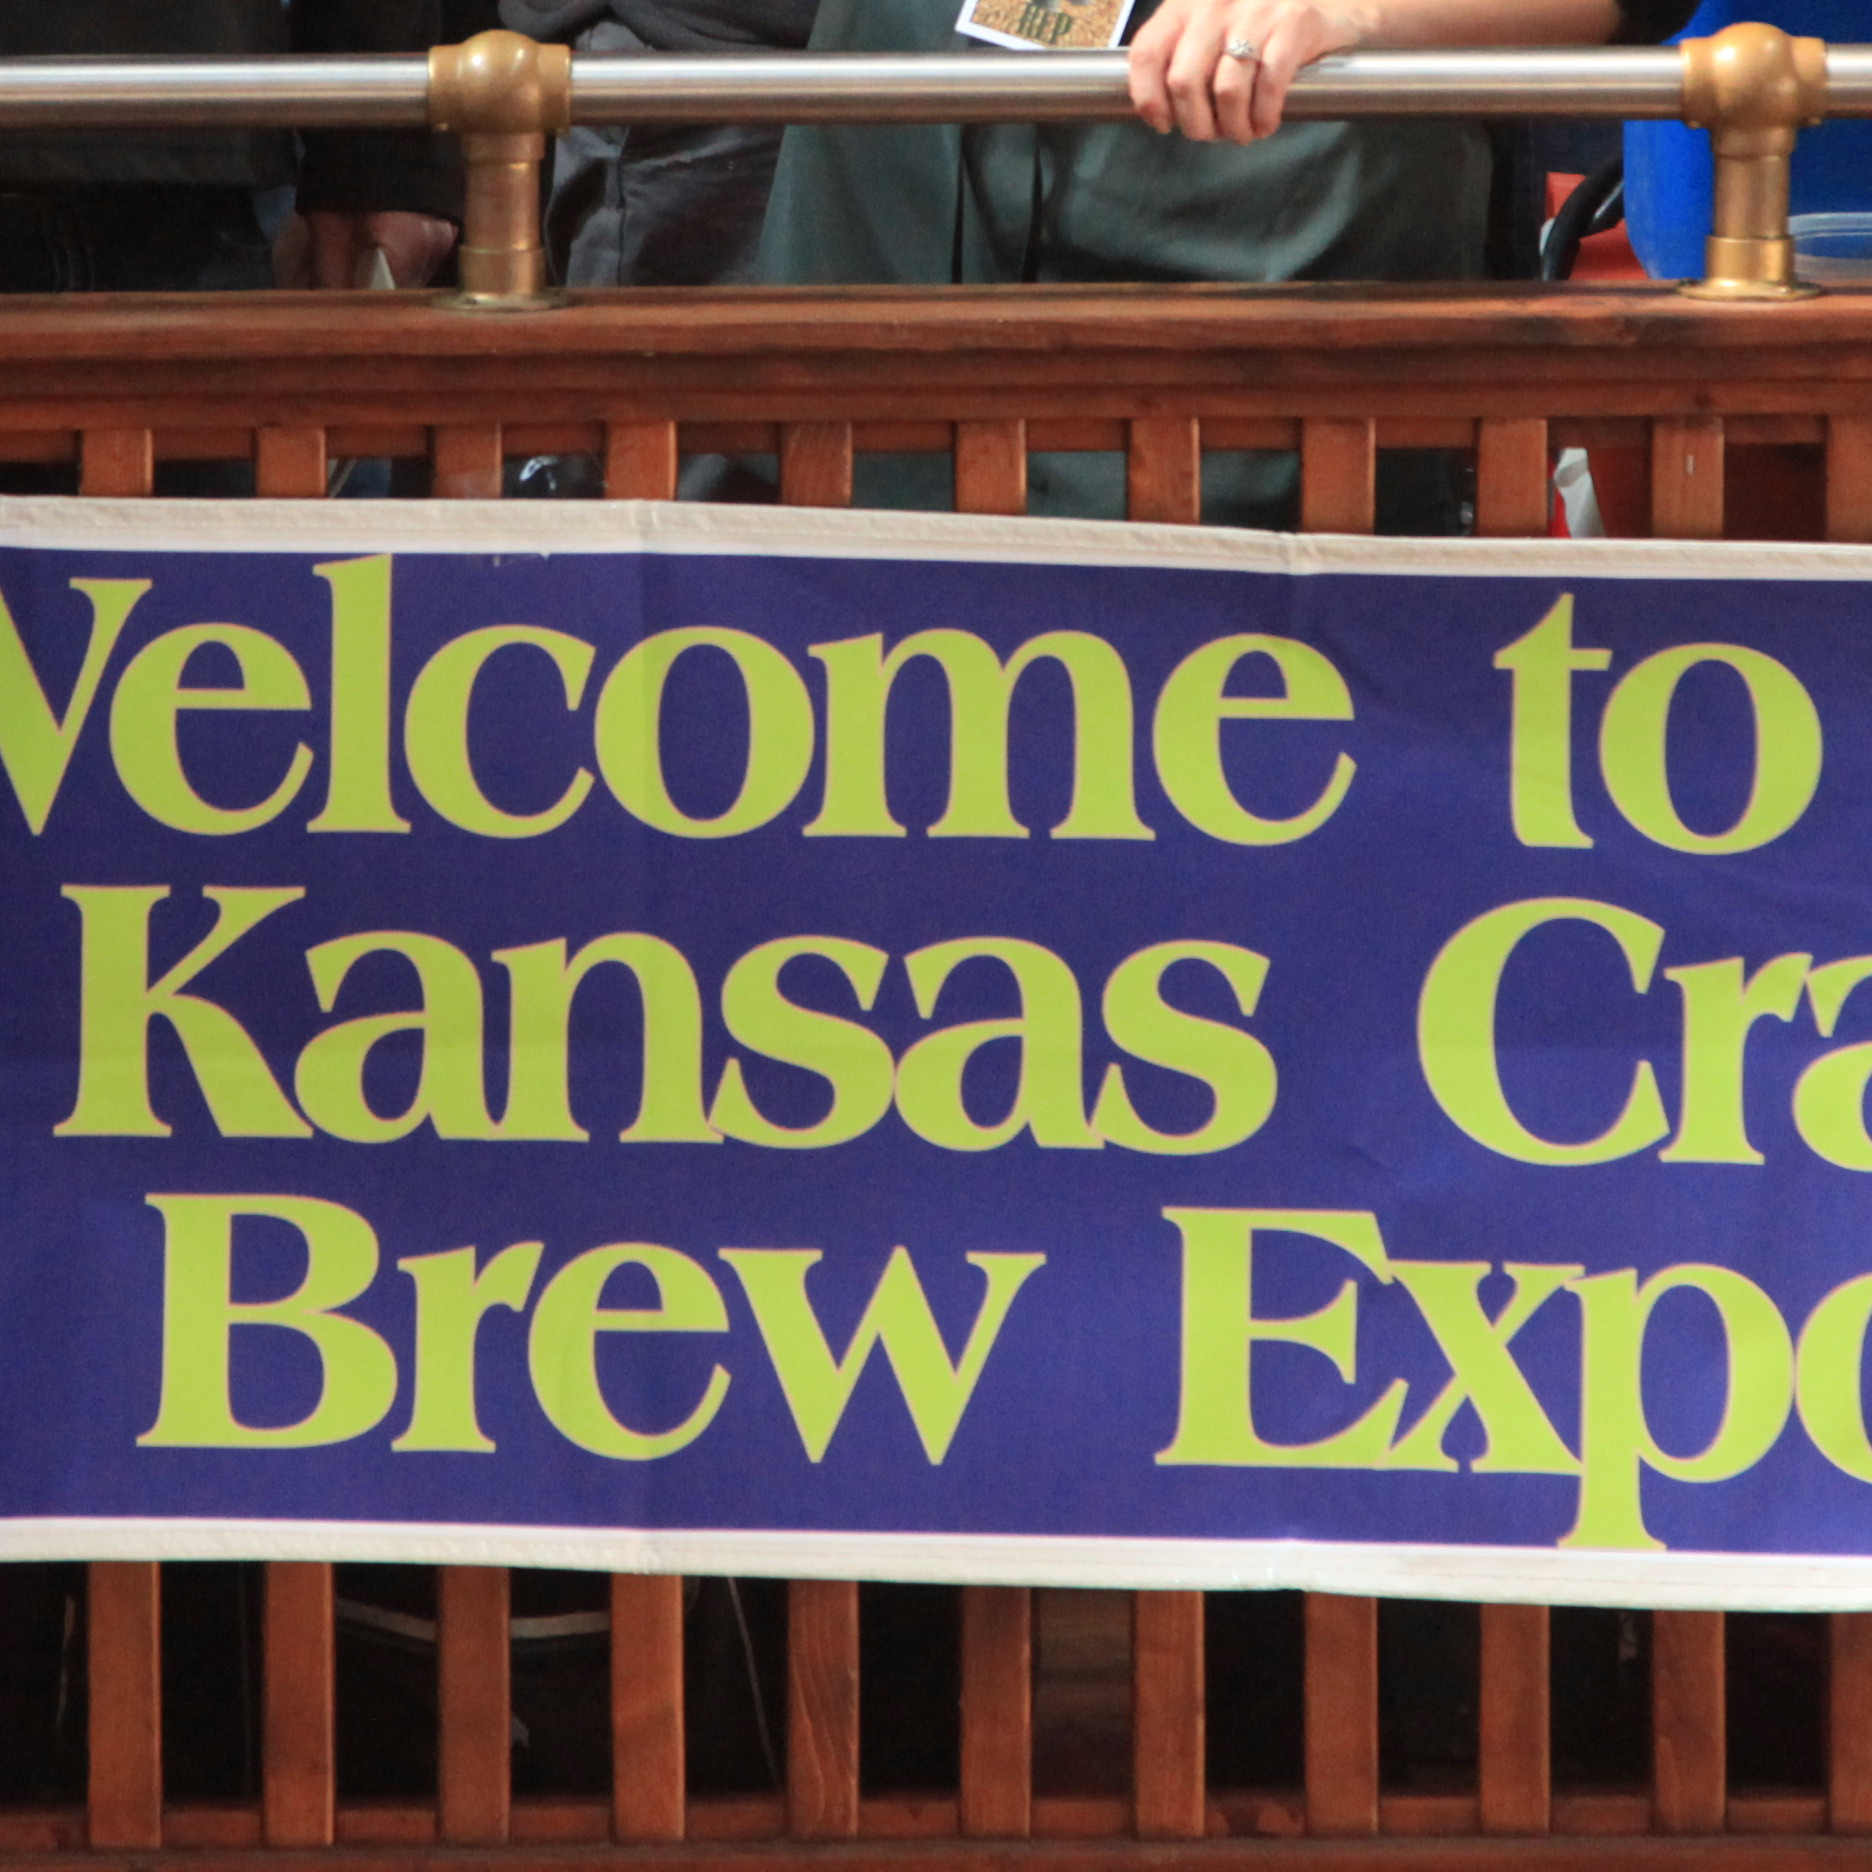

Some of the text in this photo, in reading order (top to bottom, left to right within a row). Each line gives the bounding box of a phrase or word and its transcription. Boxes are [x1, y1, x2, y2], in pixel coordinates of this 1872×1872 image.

[1015, 1, 1073, 46] REP
[1493, 592, 1824, 856] to
[52, 883, 1279, 1158] Kansas
[134, 1191, 1049, 1466] Brew
